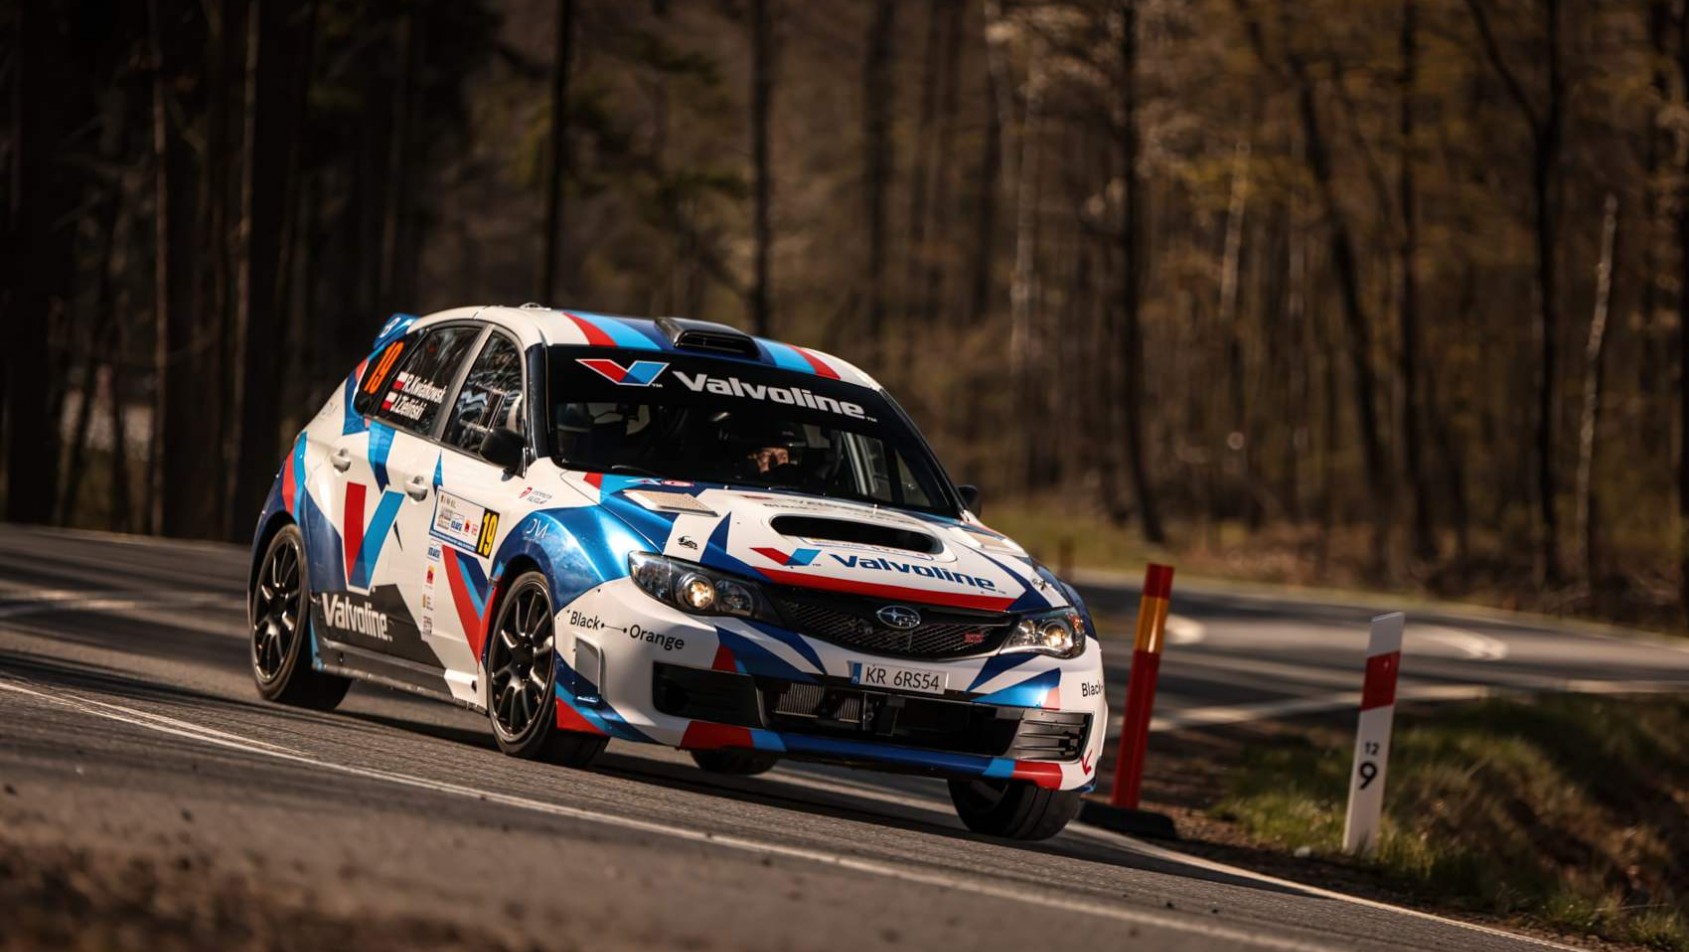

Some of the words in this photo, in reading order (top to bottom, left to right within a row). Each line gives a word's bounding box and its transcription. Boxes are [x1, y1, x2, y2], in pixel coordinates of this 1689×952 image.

[363, 341, 404, 394] 19
[672, 370, 864, 419] Valvoline
[478, 512, 498, 557] 19
[828, 553, 996, 591] Valvoline
[322, 592, 389, 640] Valvoline
[570, 611, 600, 630] Black
[629, 624, 685, 651] Orange
[865, 667, 886, 685] KR
[893, 671, 940, 691] 6RS54
[1365, 742, 1379, 755] 12
[1360, 762, 1377, 789] 9
